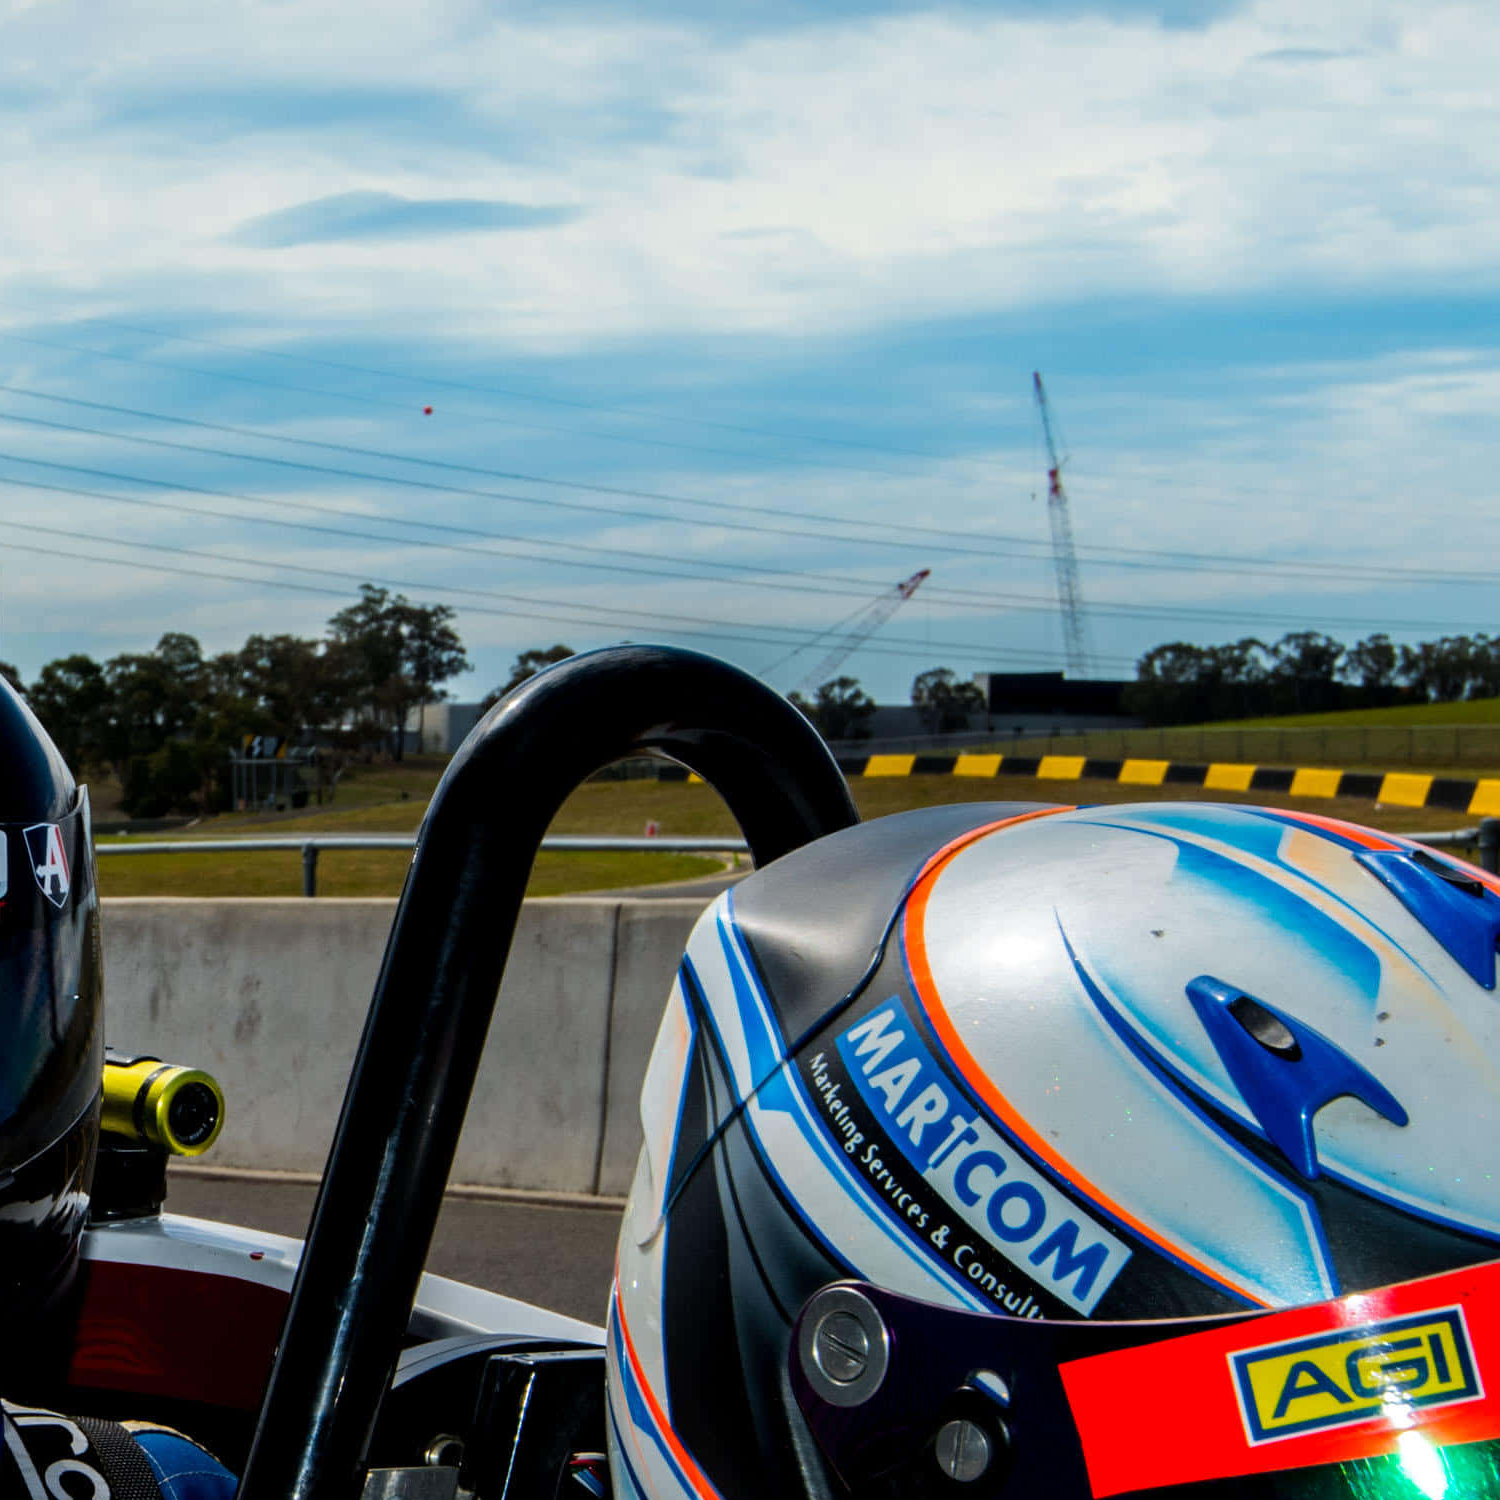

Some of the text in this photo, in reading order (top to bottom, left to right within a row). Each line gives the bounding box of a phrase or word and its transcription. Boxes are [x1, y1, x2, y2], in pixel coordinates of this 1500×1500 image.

[809, 1052, 1045, 1320] Marketing Services & Consult
[847, 1008, 1110, 1302] MARTCOM
[1272, 1332, 1452, 1420] AGI
